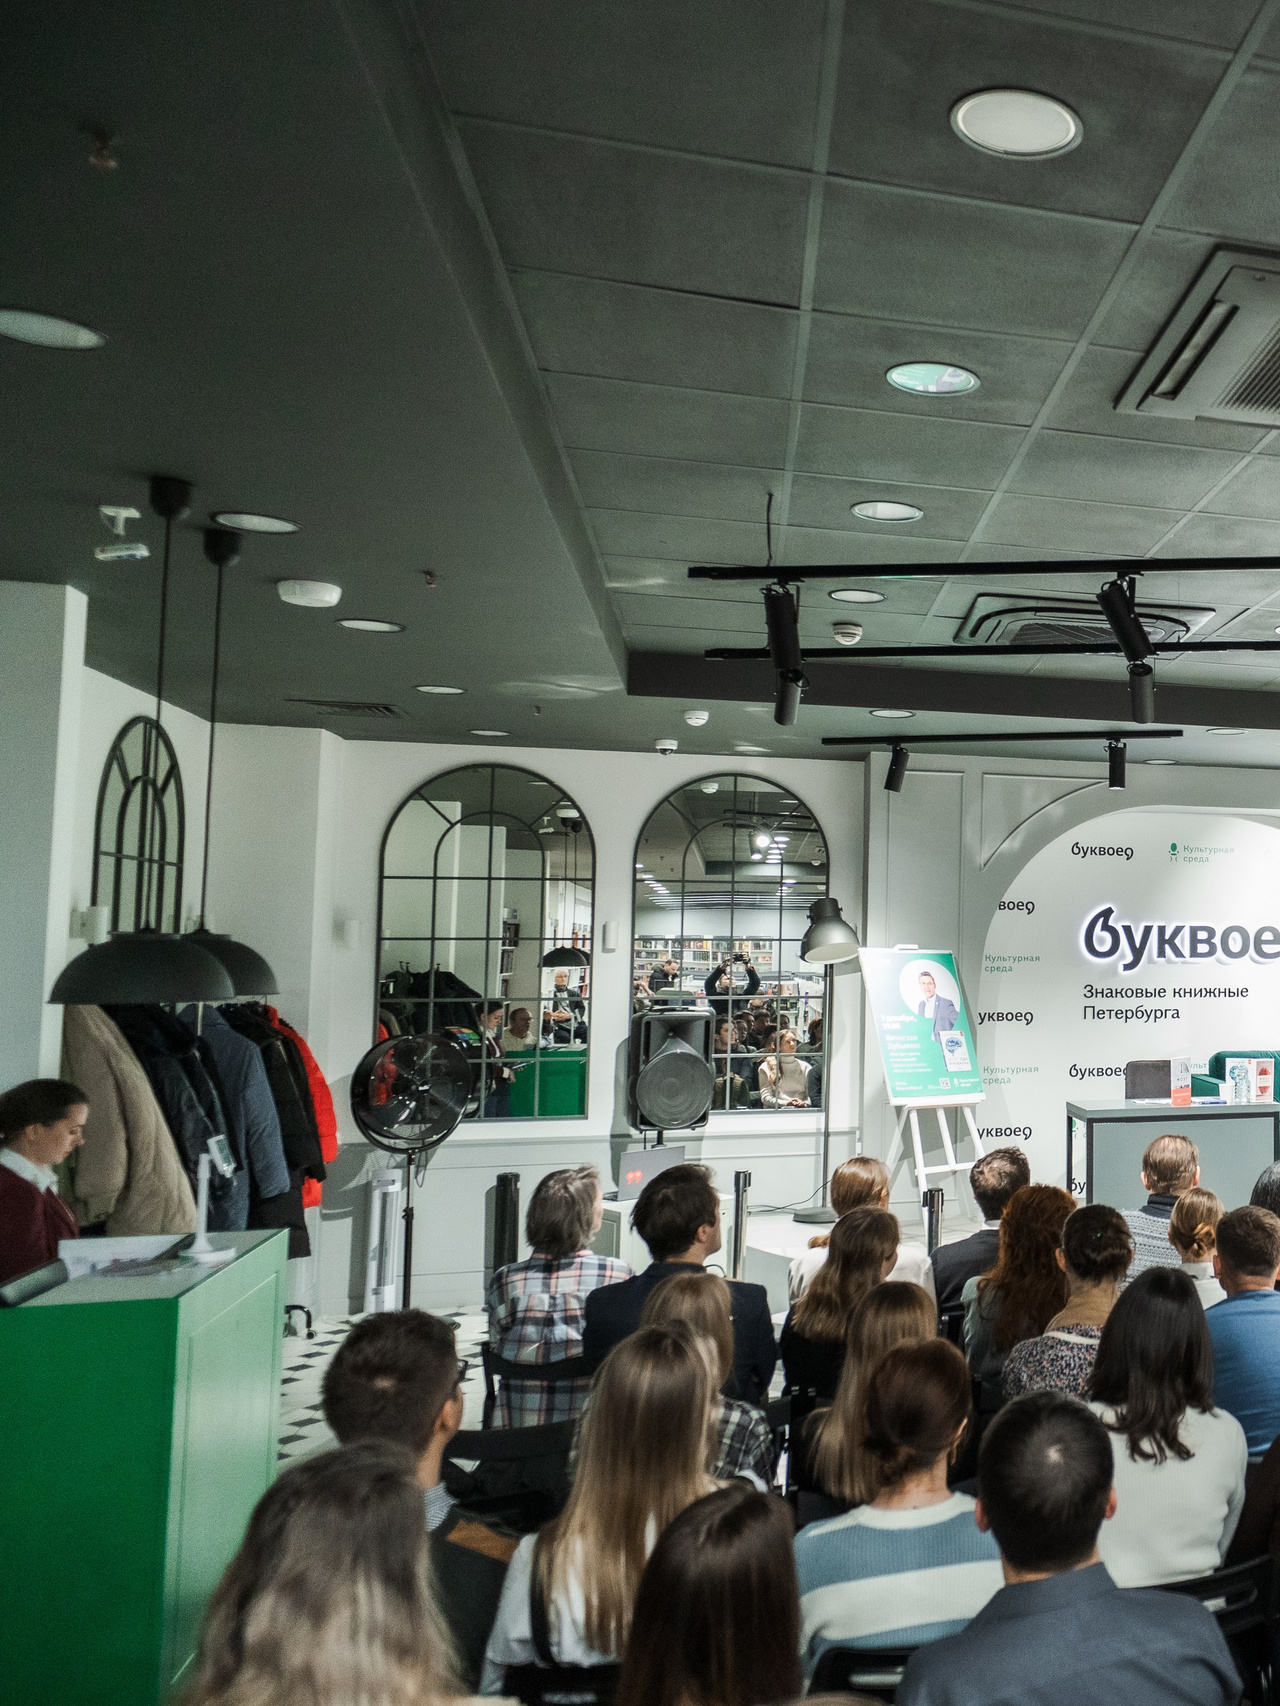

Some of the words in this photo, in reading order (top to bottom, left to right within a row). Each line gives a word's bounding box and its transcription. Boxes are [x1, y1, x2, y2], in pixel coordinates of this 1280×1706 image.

[1071, 841, 1134, 861] буквоед
[1183, 845, 1235, 855] Культурная
[1183, 856, 1210, 864] среда
[998, 900, 1036, 915] воед
[984, 954, 1041, 964] Культурная
[984, 965, 1013, 973] среда
[1083, 984, 1167, 999] Знаковые
[1172, 985, 1249, 998] книжные
[977, 1011, 1034, 1026] уквоед
[1083, 1004, 1181, 1024] Петербурга
[983, 1065, 1039, 1075] Культурная
[983, 1077, 1011, 1085] среда
[977, 1126, 1033, 1141] уквоед
